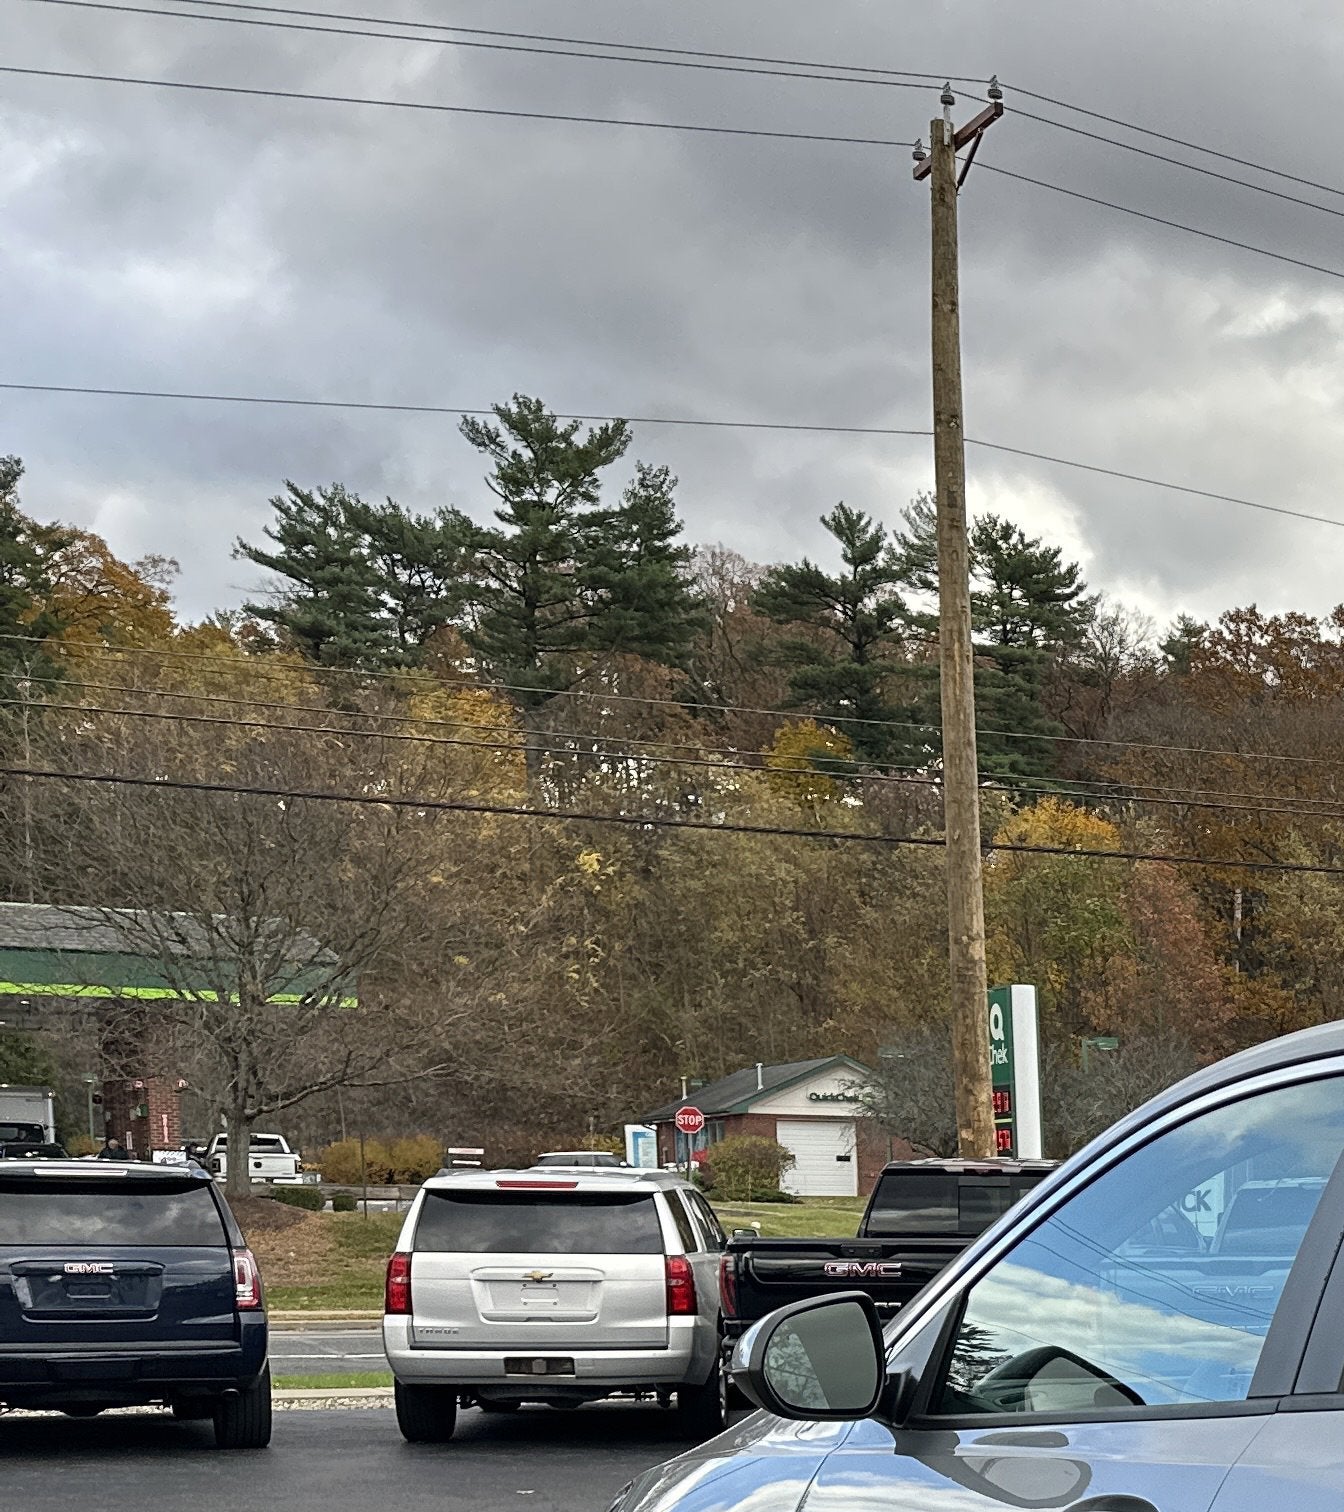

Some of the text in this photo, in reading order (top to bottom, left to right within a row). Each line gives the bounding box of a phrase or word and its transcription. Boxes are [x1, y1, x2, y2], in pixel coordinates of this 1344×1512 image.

[676, 1114, 702, 1126] STOP
[64, 1263, 114, 1273] GMC
[824, 1262, 902, 1277] GMC
